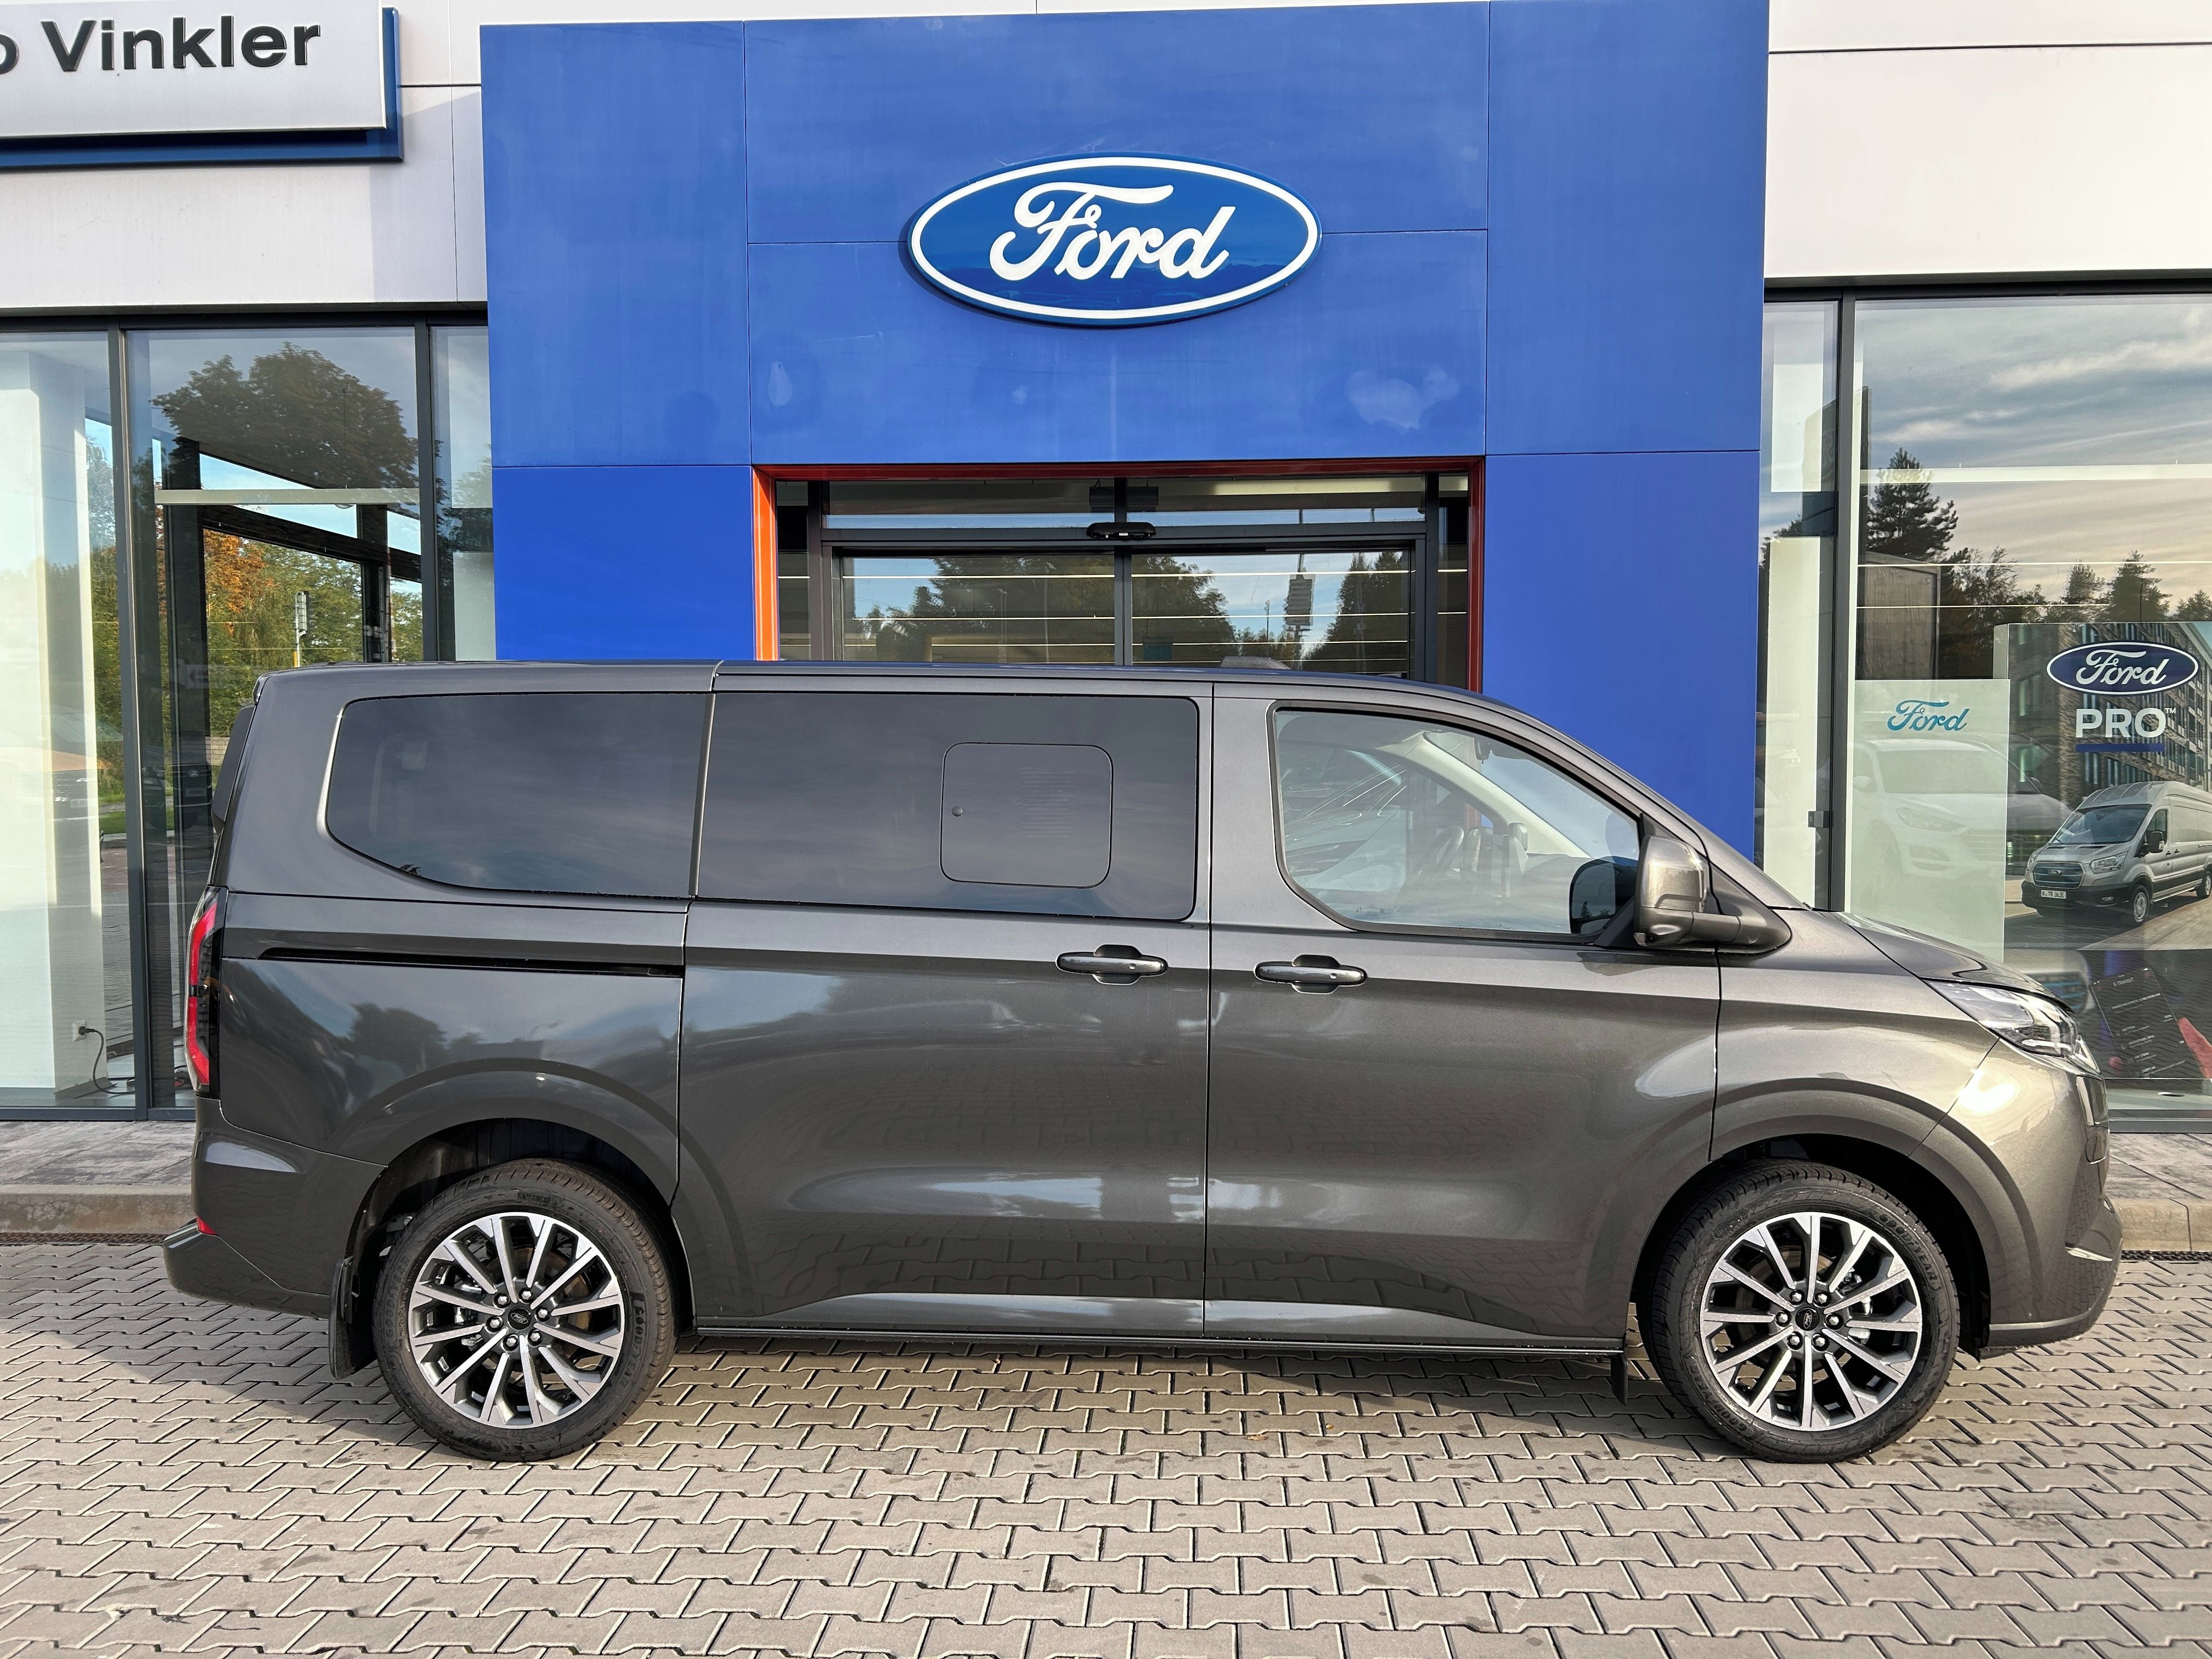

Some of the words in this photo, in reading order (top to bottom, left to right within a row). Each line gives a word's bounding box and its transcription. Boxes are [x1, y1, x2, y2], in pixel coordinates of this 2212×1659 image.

[41, 16, 321, 72] Vinkler
[989, 182, 1236, 281] Ford
[2076, 649, 2170, 685] Ford
[1887, 700, 1970, 731] Ford
[1879, 1214, 1938, 1280] GOODYEAR
